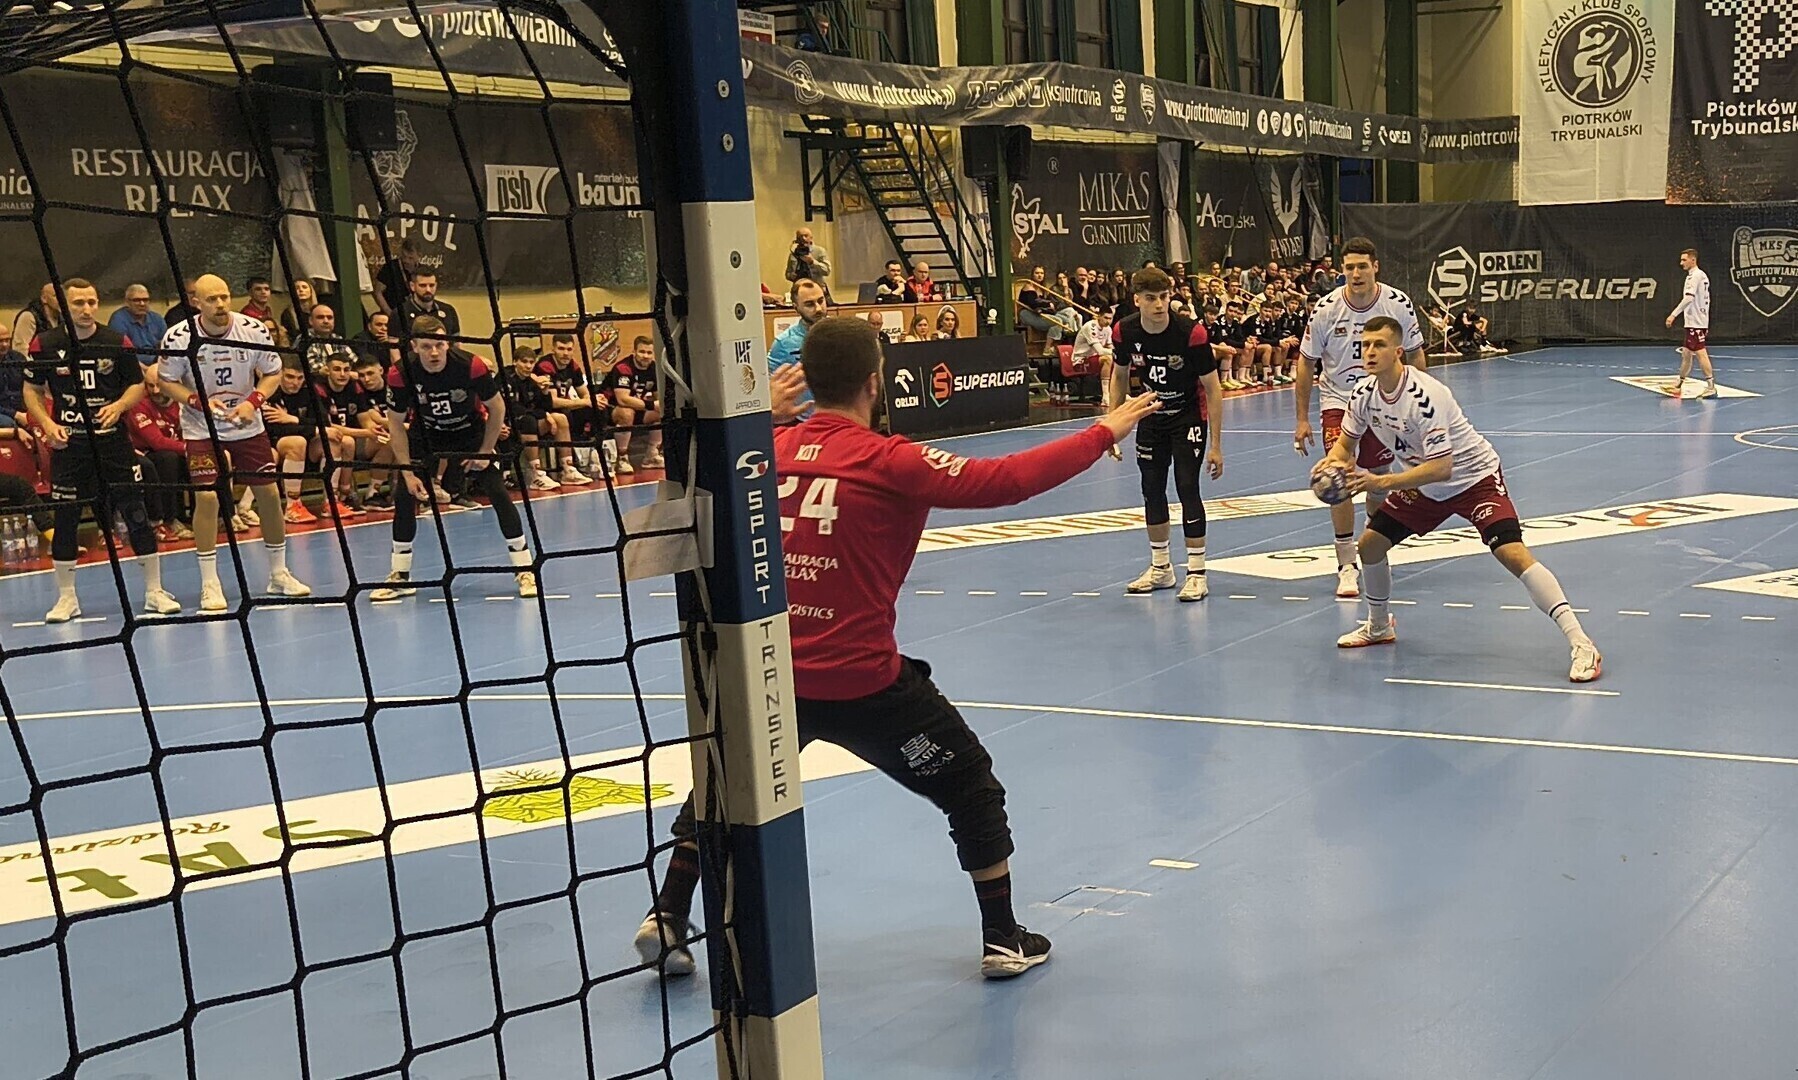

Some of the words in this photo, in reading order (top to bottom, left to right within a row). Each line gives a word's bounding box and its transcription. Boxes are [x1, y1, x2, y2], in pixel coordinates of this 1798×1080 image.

[1538, 5, 1577, 93] ATLETYCZNY
[1624, 3, 1657, 84] SPORTOWY
[1562, 109, 1633, 126] PIOTRKÓW
[1706, 98, 1798, 118] Piotrków
[1550, 124, 1643, 142] TRYBUNALSKI
[497, 170, 533, 211] psb
[1079, 171, 1150, 212] MIKAS
[1015, 213, 1069, 234] STAL
[1081, 222, 1151, 246] GARNITURY
[1759, 241, 1783, 251] MKS
[1483, 252, 1539, 272] ORLEN
[1480, 277, 1657, 302] SUPERLIGA
[215, 367, 233, 387] 32
[954, 370, 1025, 392] SUPERLIGA
[1149, 365, 1167, 385] 42
[431, 400, 452, 416] 23
[895, 396, 919, 409] ORLEN
[1187, 426, 1203, 443] 42
[747, 489, 773, 605] SPORT
[760, 620, 789, 803] TRANSFER
